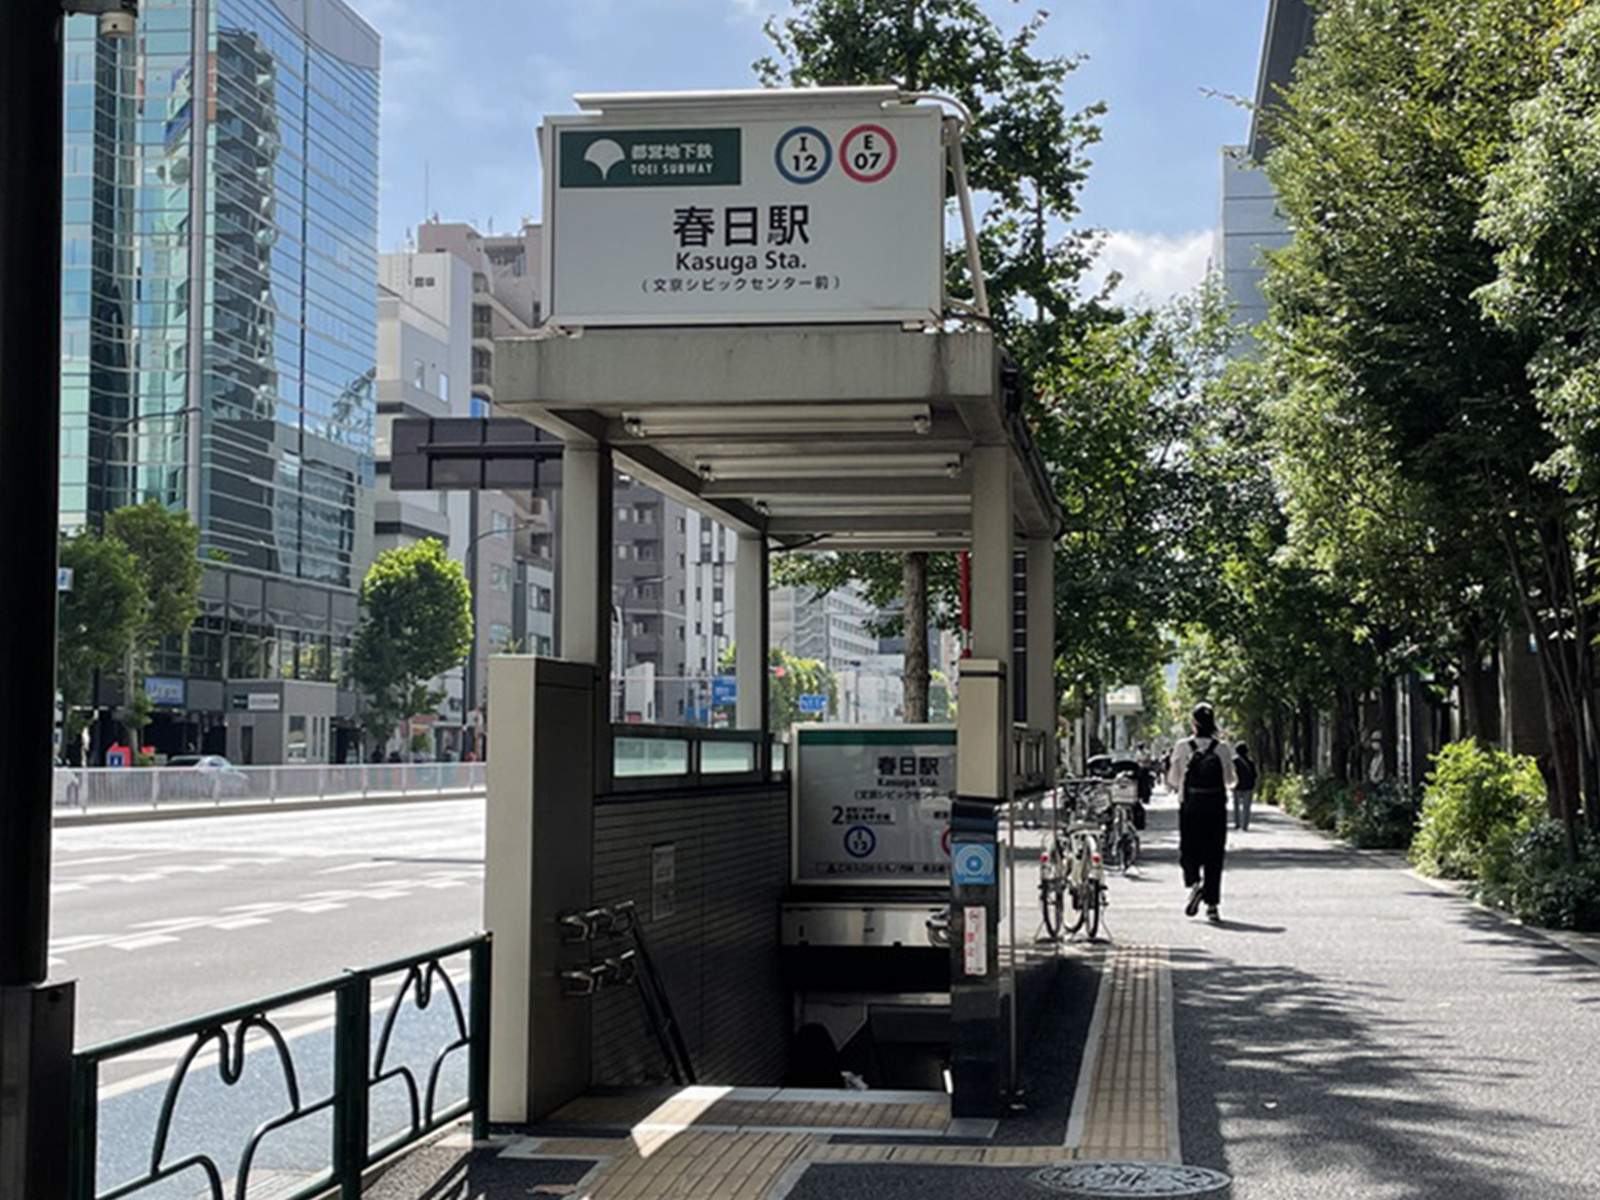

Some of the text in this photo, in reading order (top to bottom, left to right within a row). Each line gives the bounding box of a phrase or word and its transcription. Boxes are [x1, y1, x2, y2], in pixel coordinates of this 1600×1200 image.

[799, 136, 808, 152] I
[864, 134, 874, 150] E
[631, 143, 714, 160] 都営地下鉄
[631, 163, 713, 176] TOEI SUBWAY
[792, 154, 818, 172] 12
[854, 152, 882, 170] 07
[673, 205, 810, 248] 春日駅
[676, 250, 807, 276] Kasuga Sta.
[831, 805, 844, 825] 2
